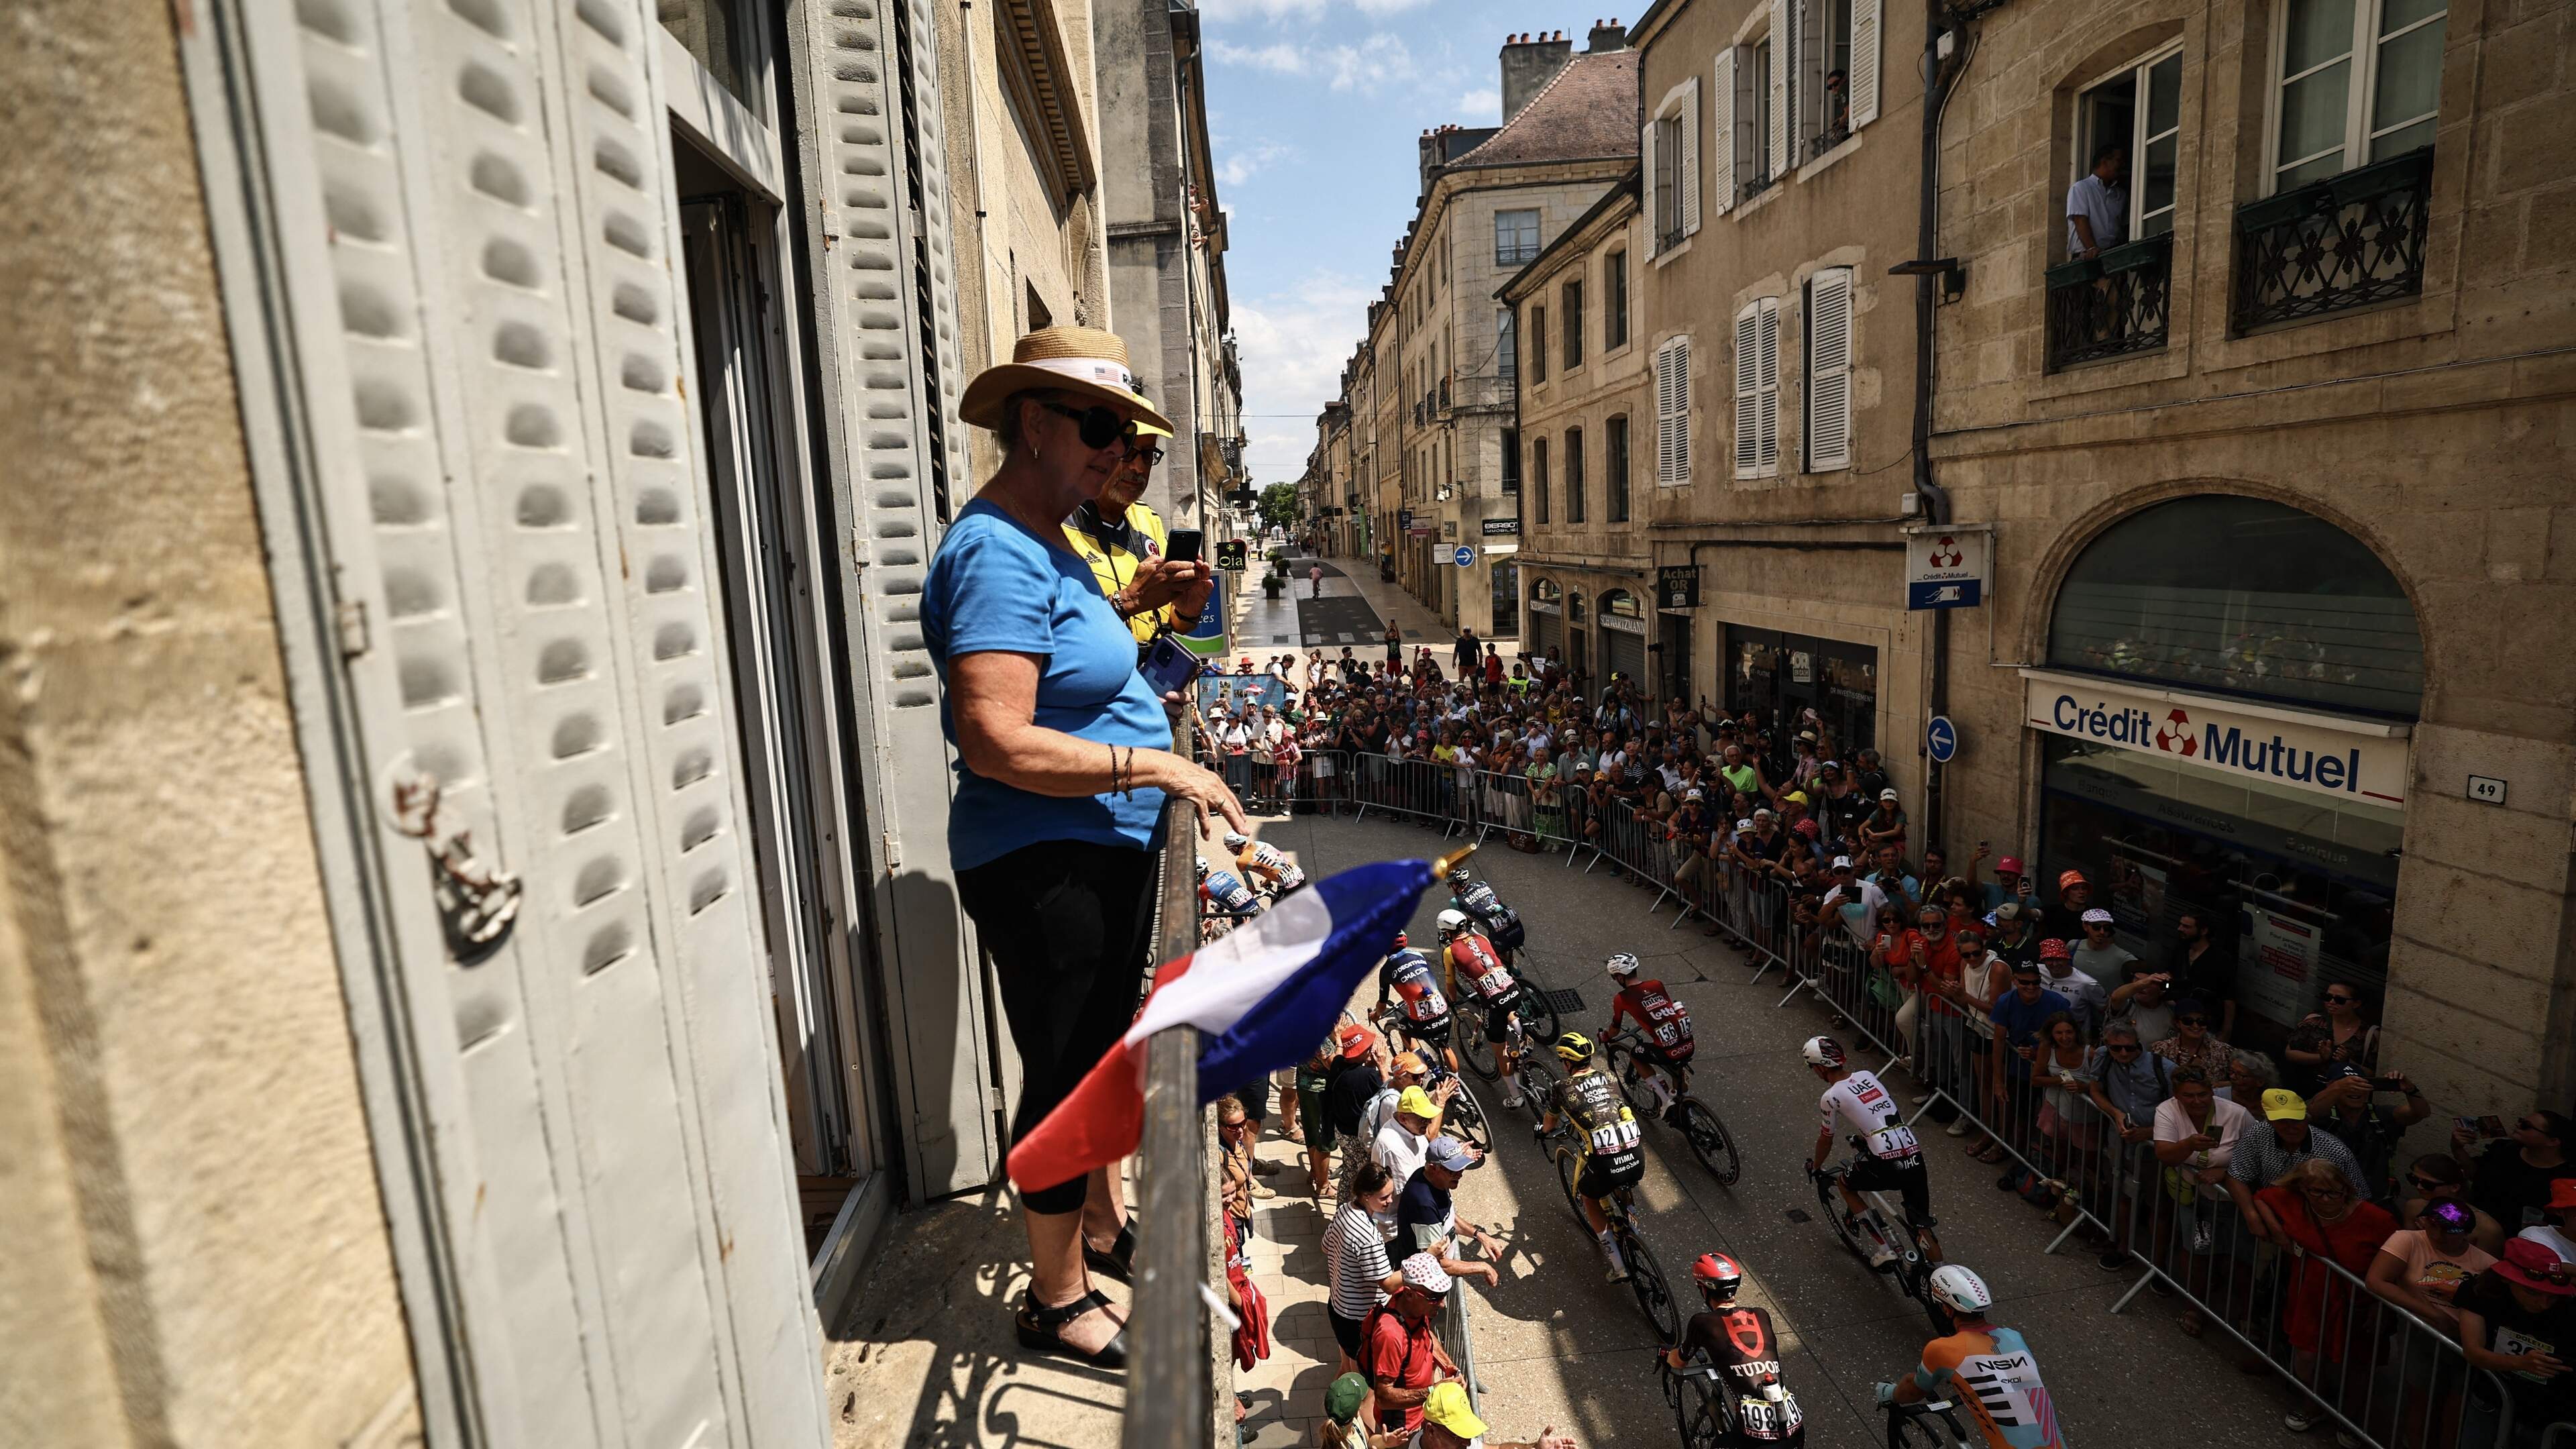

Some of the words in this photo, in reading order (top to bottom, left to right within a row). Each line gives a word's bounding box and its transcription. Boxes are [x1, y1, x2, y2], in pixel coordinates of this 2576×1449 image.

[1220, 555, 1243, 567] Oia
[1663, 568, 1696, 580] Achat
[1670, 580, 1688, 591] OR
[1599, 613, 1645, 635] SCHWARTZMANN
[2054, 695, 2151, 747] Crédit
[2204, 722, 2360, 793] Mutuel
[2477, 784, 2496, 796] 49
[2286, 837, 2349, 865] Banque
[1397, 959, 1427, 973] DECATHLON
[1401, 971, 1417, 983] CMA
[1481, 974, 1499, 989] 162
[1499, 990, 1519, 1004] Cofidis
[1418, 1001, 1433, 1014] 52
[1432, 1016, 1449, 1028] Shine
[1680, 1017, 1691, 1034] 15
[1656, 1024, 1677, 1042] 156
[1575, 1075, 1608, 1092] VISMA
[1847, 1079, 1874, 1095] UAE
[1584, 1087, 1608, 1098] lease
[1868, 1100, 1891, 1114] XRG
[1625, 1122, 1641, 1140] 12
[1902, 1127, 1913, 1145] 3
[1597, 1130, 1614, 1148] 12
[1881, 1132, 1893, 1150] 3
[1597, 1146, 1619, 1155] VELUX
[1880, 1150, 1902, 1159] VELUX
[1613, 1153, 1635, 1165] VISMA
[1904, 1155, 1919, 1169] IHC
[1611, 1166, 1625, 1174] lease
[1730, 1360, 1780, 1377] TUDOR
[1742, 1405, 1778, 1430] 198
[1745, 1429, 1776, 1439] VELUX
